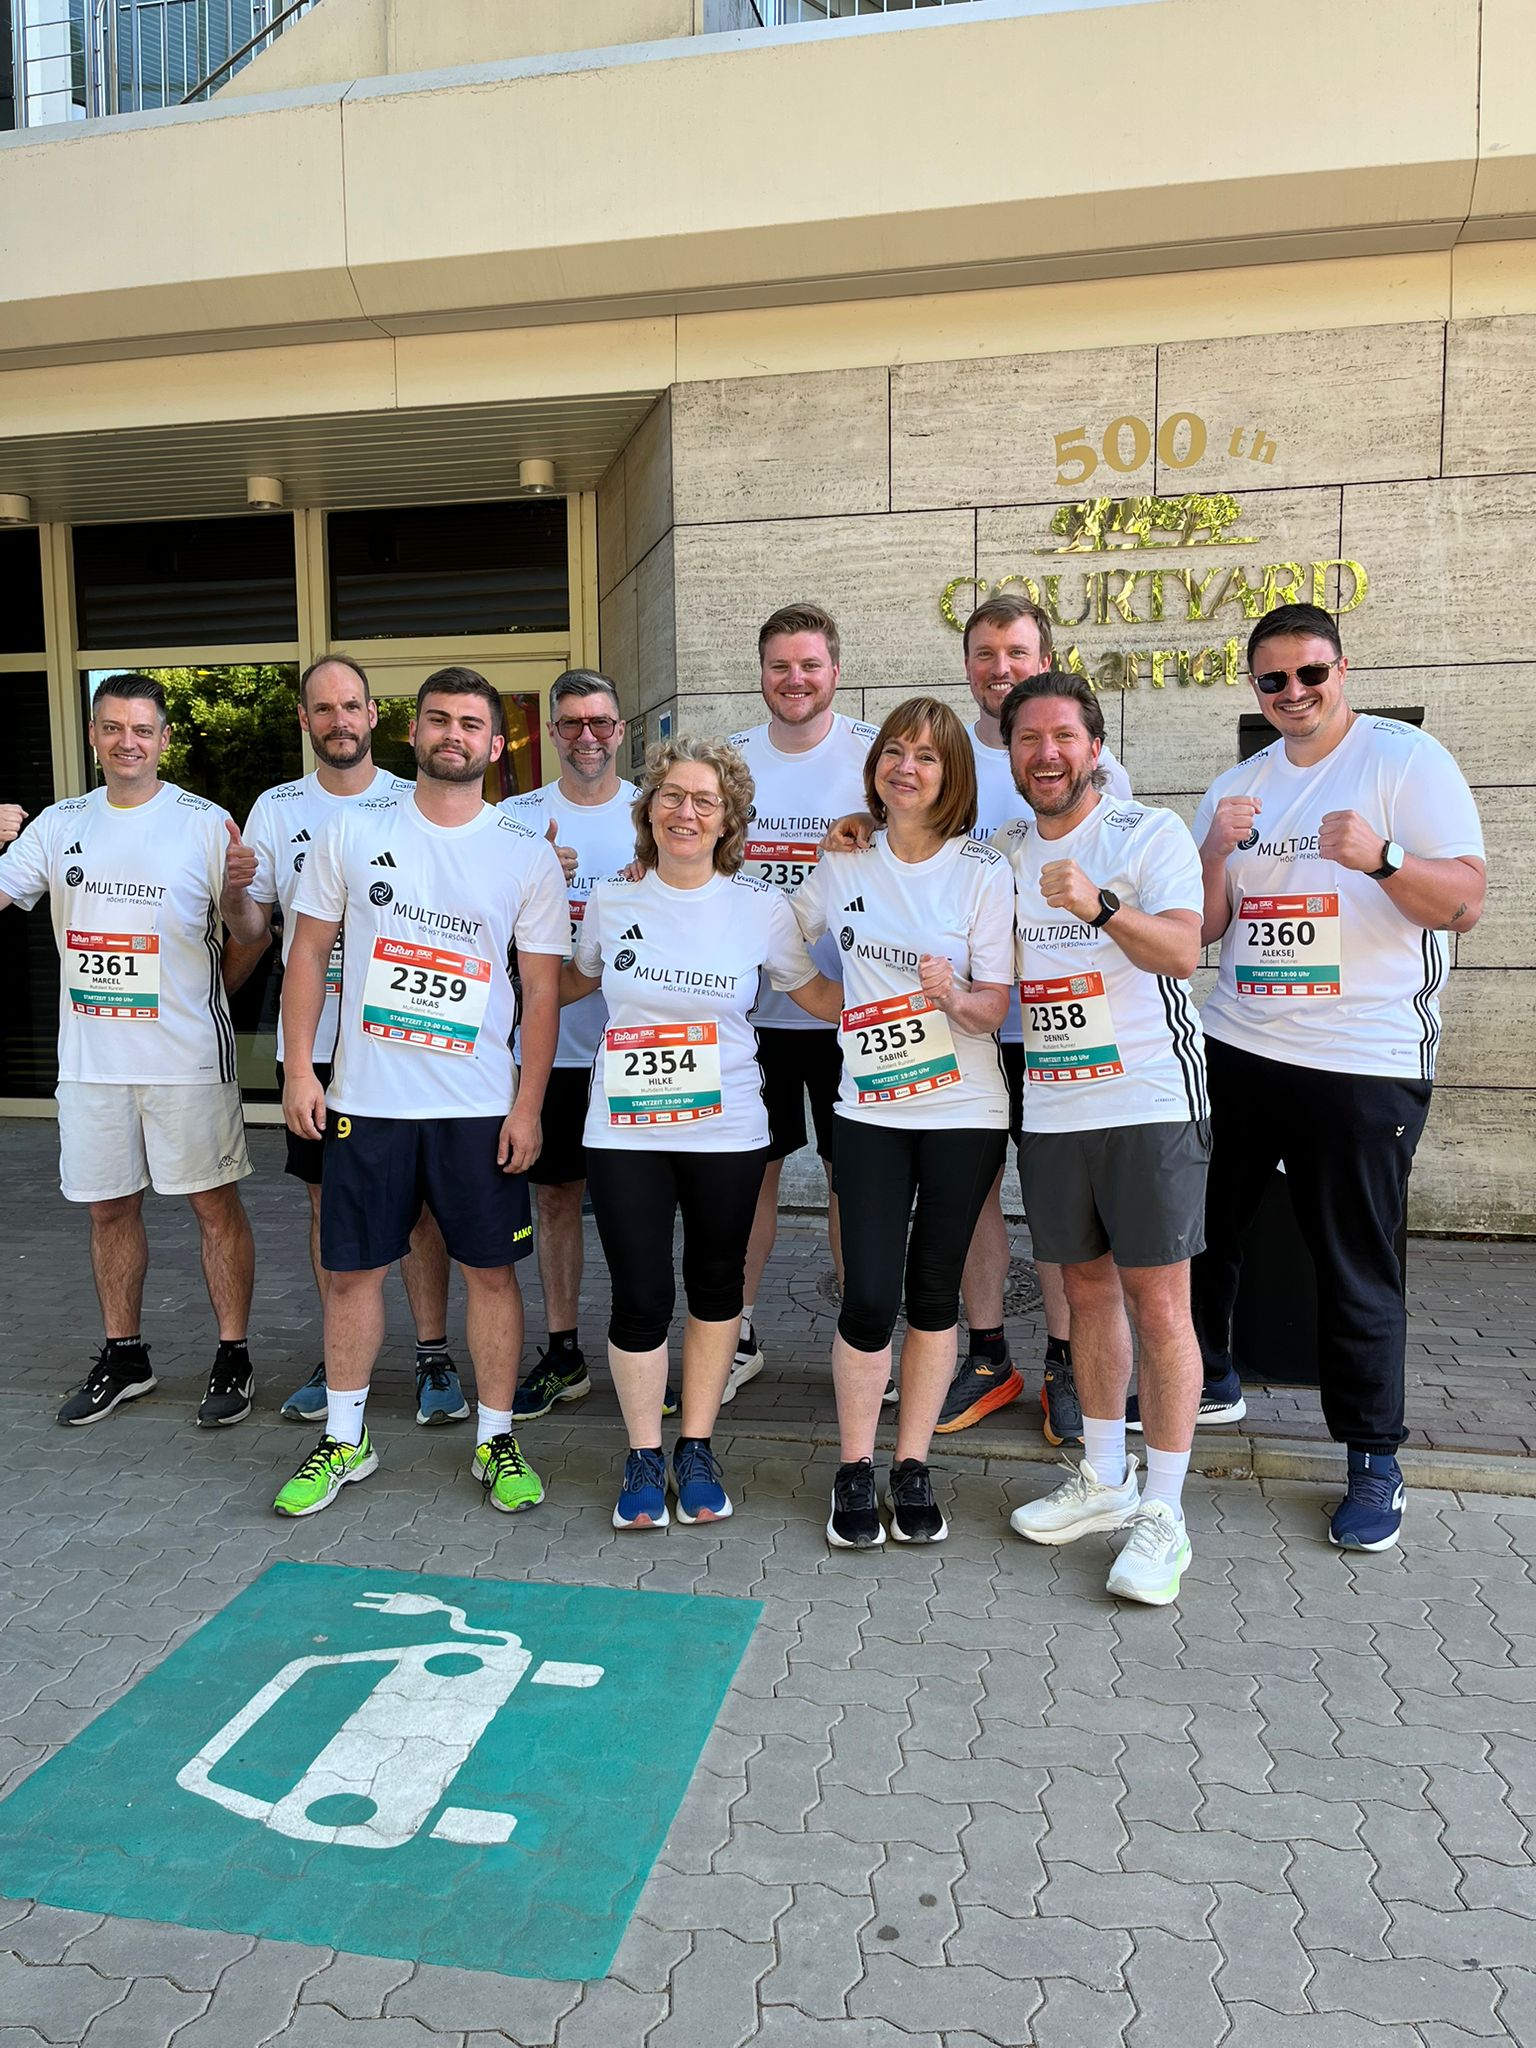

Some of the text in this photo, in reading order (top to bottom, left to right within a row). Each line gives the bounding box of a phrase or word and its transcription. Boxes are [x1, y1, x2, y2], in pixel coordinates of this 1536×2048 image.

[1052, 411, 1278, 487] 500 th
[757, 817, 837, 831] MULTIDEN
[967, 844, 997, 860] valisy
[84, 881, 167, 900] MULTIDENT
[393, 902, 483, 936] MULTIDENT
[1018, 924, 1101, 942] MULTIDENT
[1247, 920, 1316, 946] 2360
[857, 944, 918, 967] MULTID
[1262, 949, 1295, 958] ALEKSEJ
[78, 953, 139, 976] 2361
[92, 977, 121, 985] MARCEL
[390, 966, 468, 1003] 2359
[633, 966, 738, 991] MULTIDENT
[662, 984, 736, 999] HÖCHST PERSÖNLICH
[411, 996, 440, 1009] LUKAS
[389, 1014, 422, 1027] STARTZEIT
[441, 1023, 454, 1032] Uhr
[1030, 1003, 1087, 1032] 2358
[856, 1018, 926, 1056] 2353
[1044, 1033, 1070, 1042] DENNIS
[624, 1048, 697, 1077] 2354
[878, 1049, 909, 1063] SABINE
[648, 1077, 673, 1086] HILKE
[871, 1074, 899, 1085] STARTZEIT
[631, 1099, 663, 1107] STARTZEIT
[336, 1116, 352, 1139] 9
